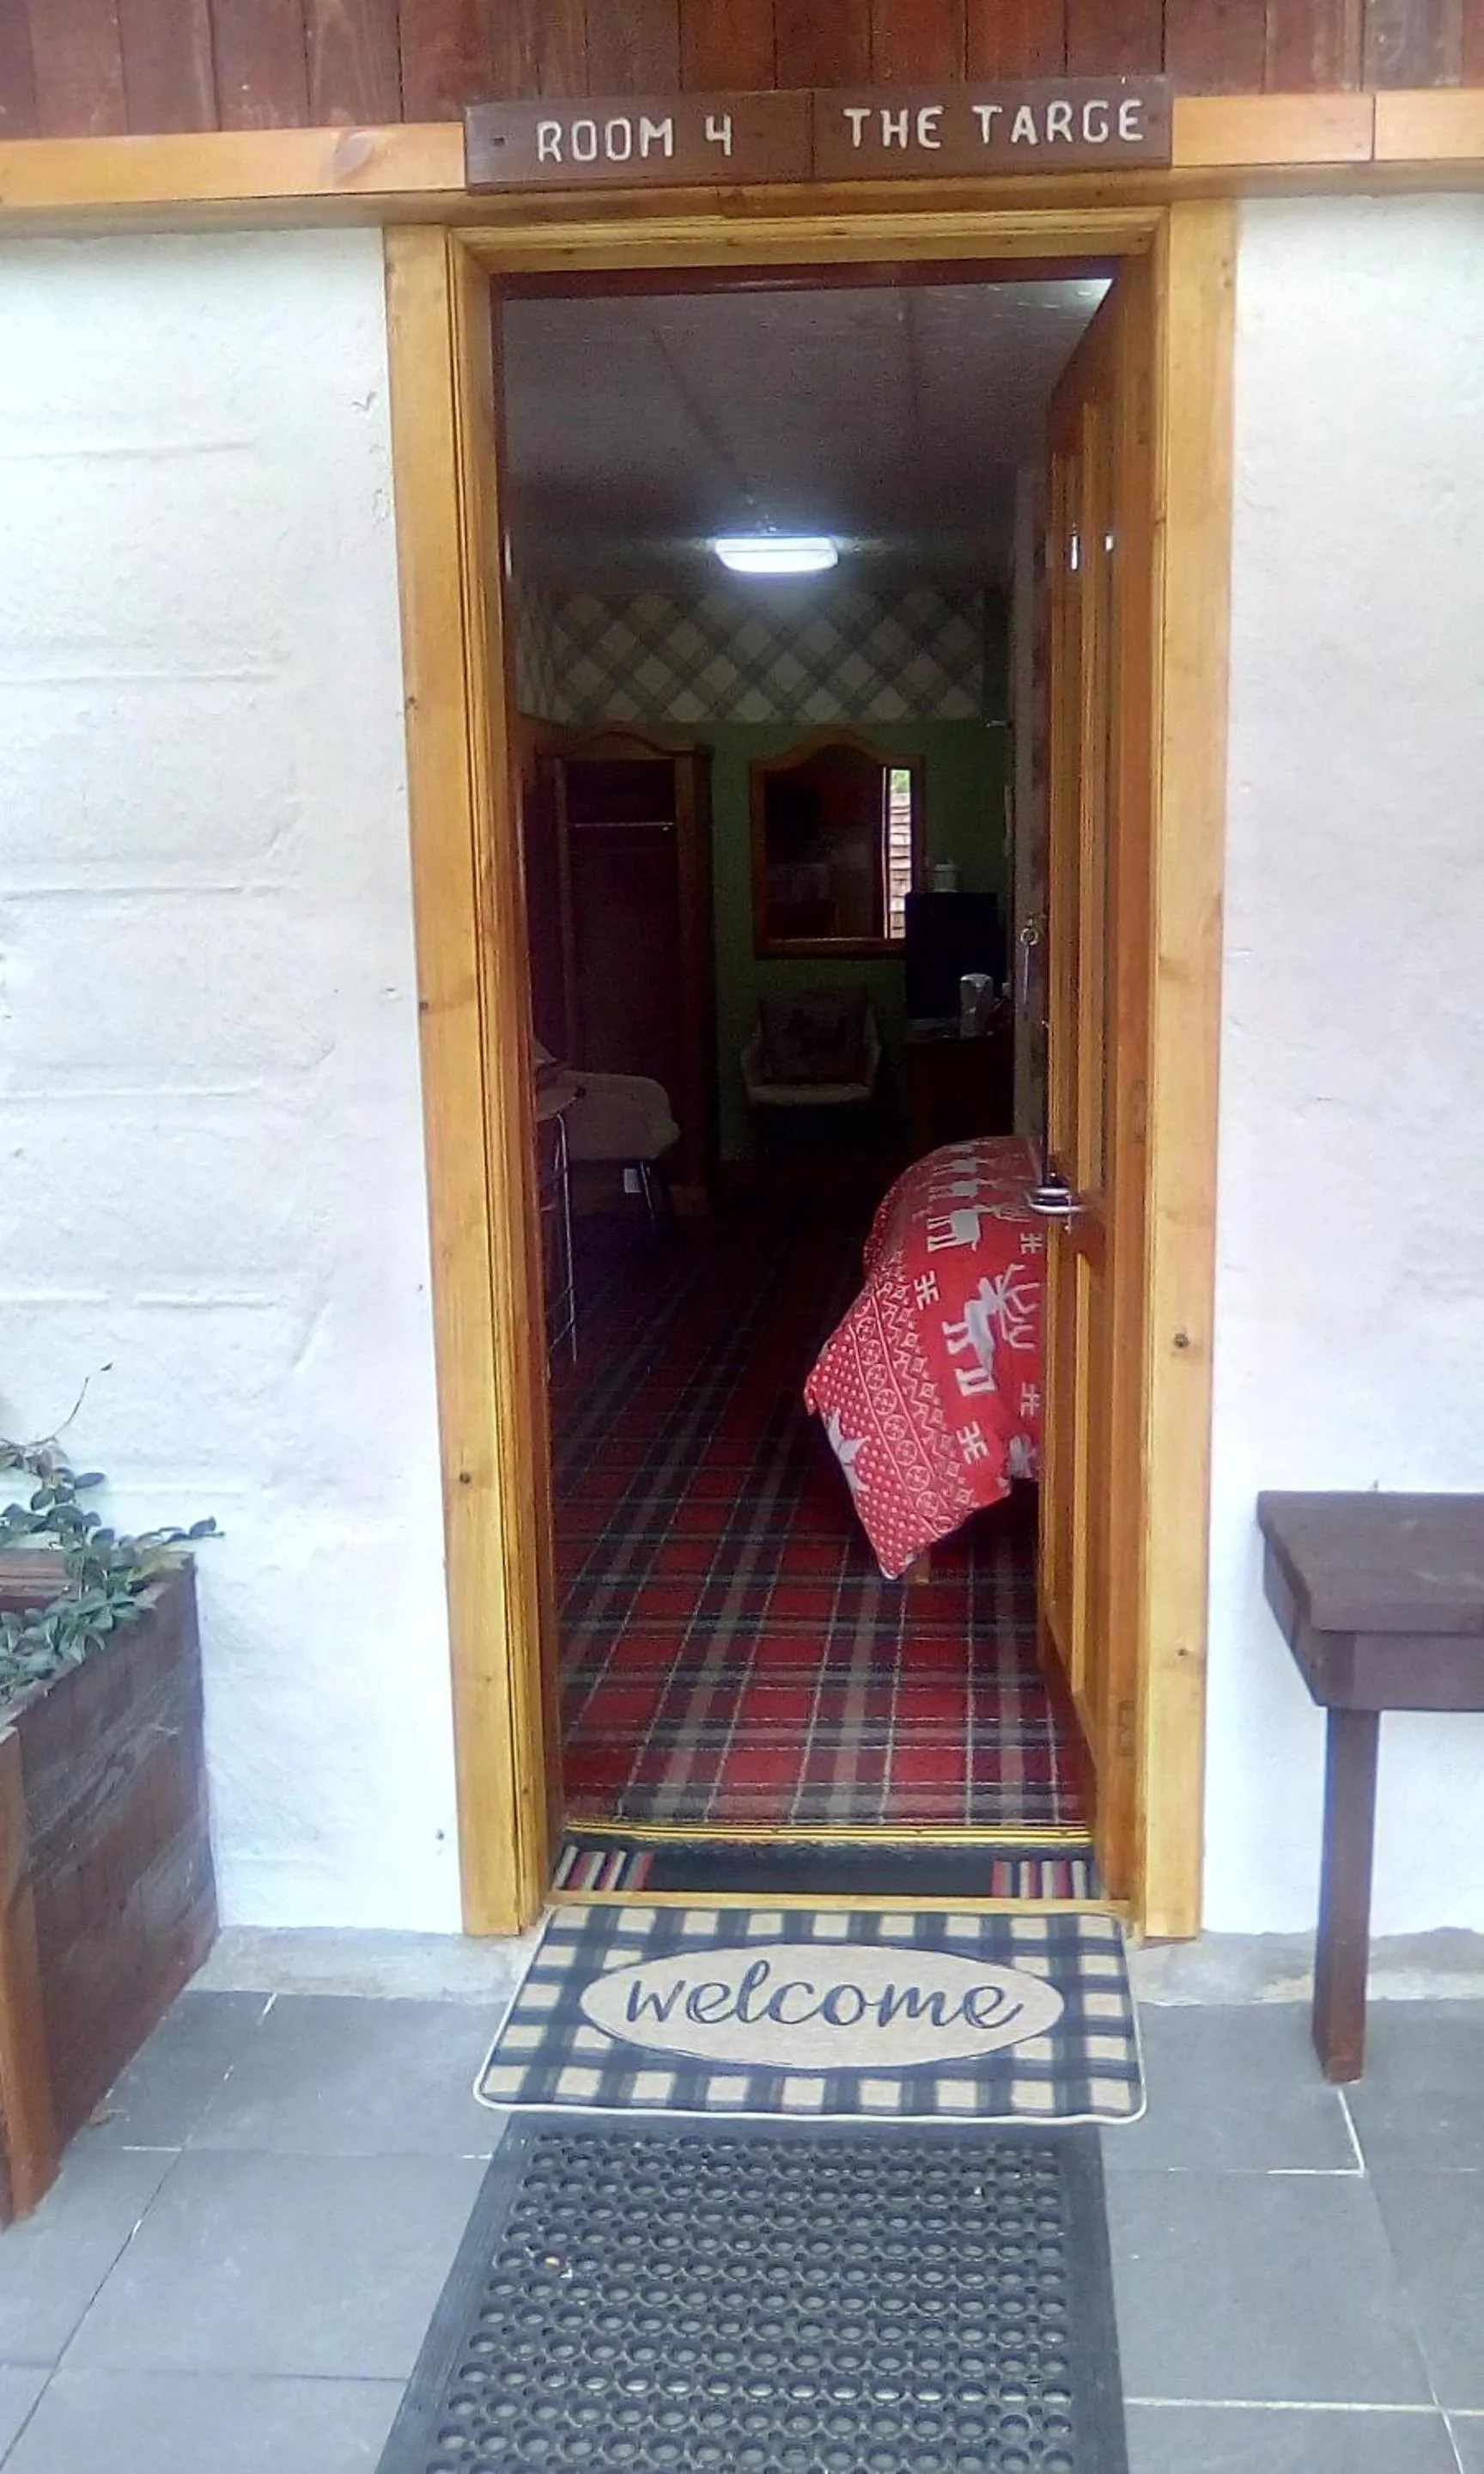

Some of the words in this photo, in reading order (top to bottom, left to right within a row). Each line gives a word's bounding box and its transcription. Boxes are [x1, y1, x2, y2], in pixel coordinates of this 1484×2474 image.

[538, 117, 673, 162] ROOM
[705, 113, 733, 156] 4
[843, 106, 943, 149] THE
[972, 99, 1145, 146] TARGE
[626, 1959, 1024, 2029] welcome
